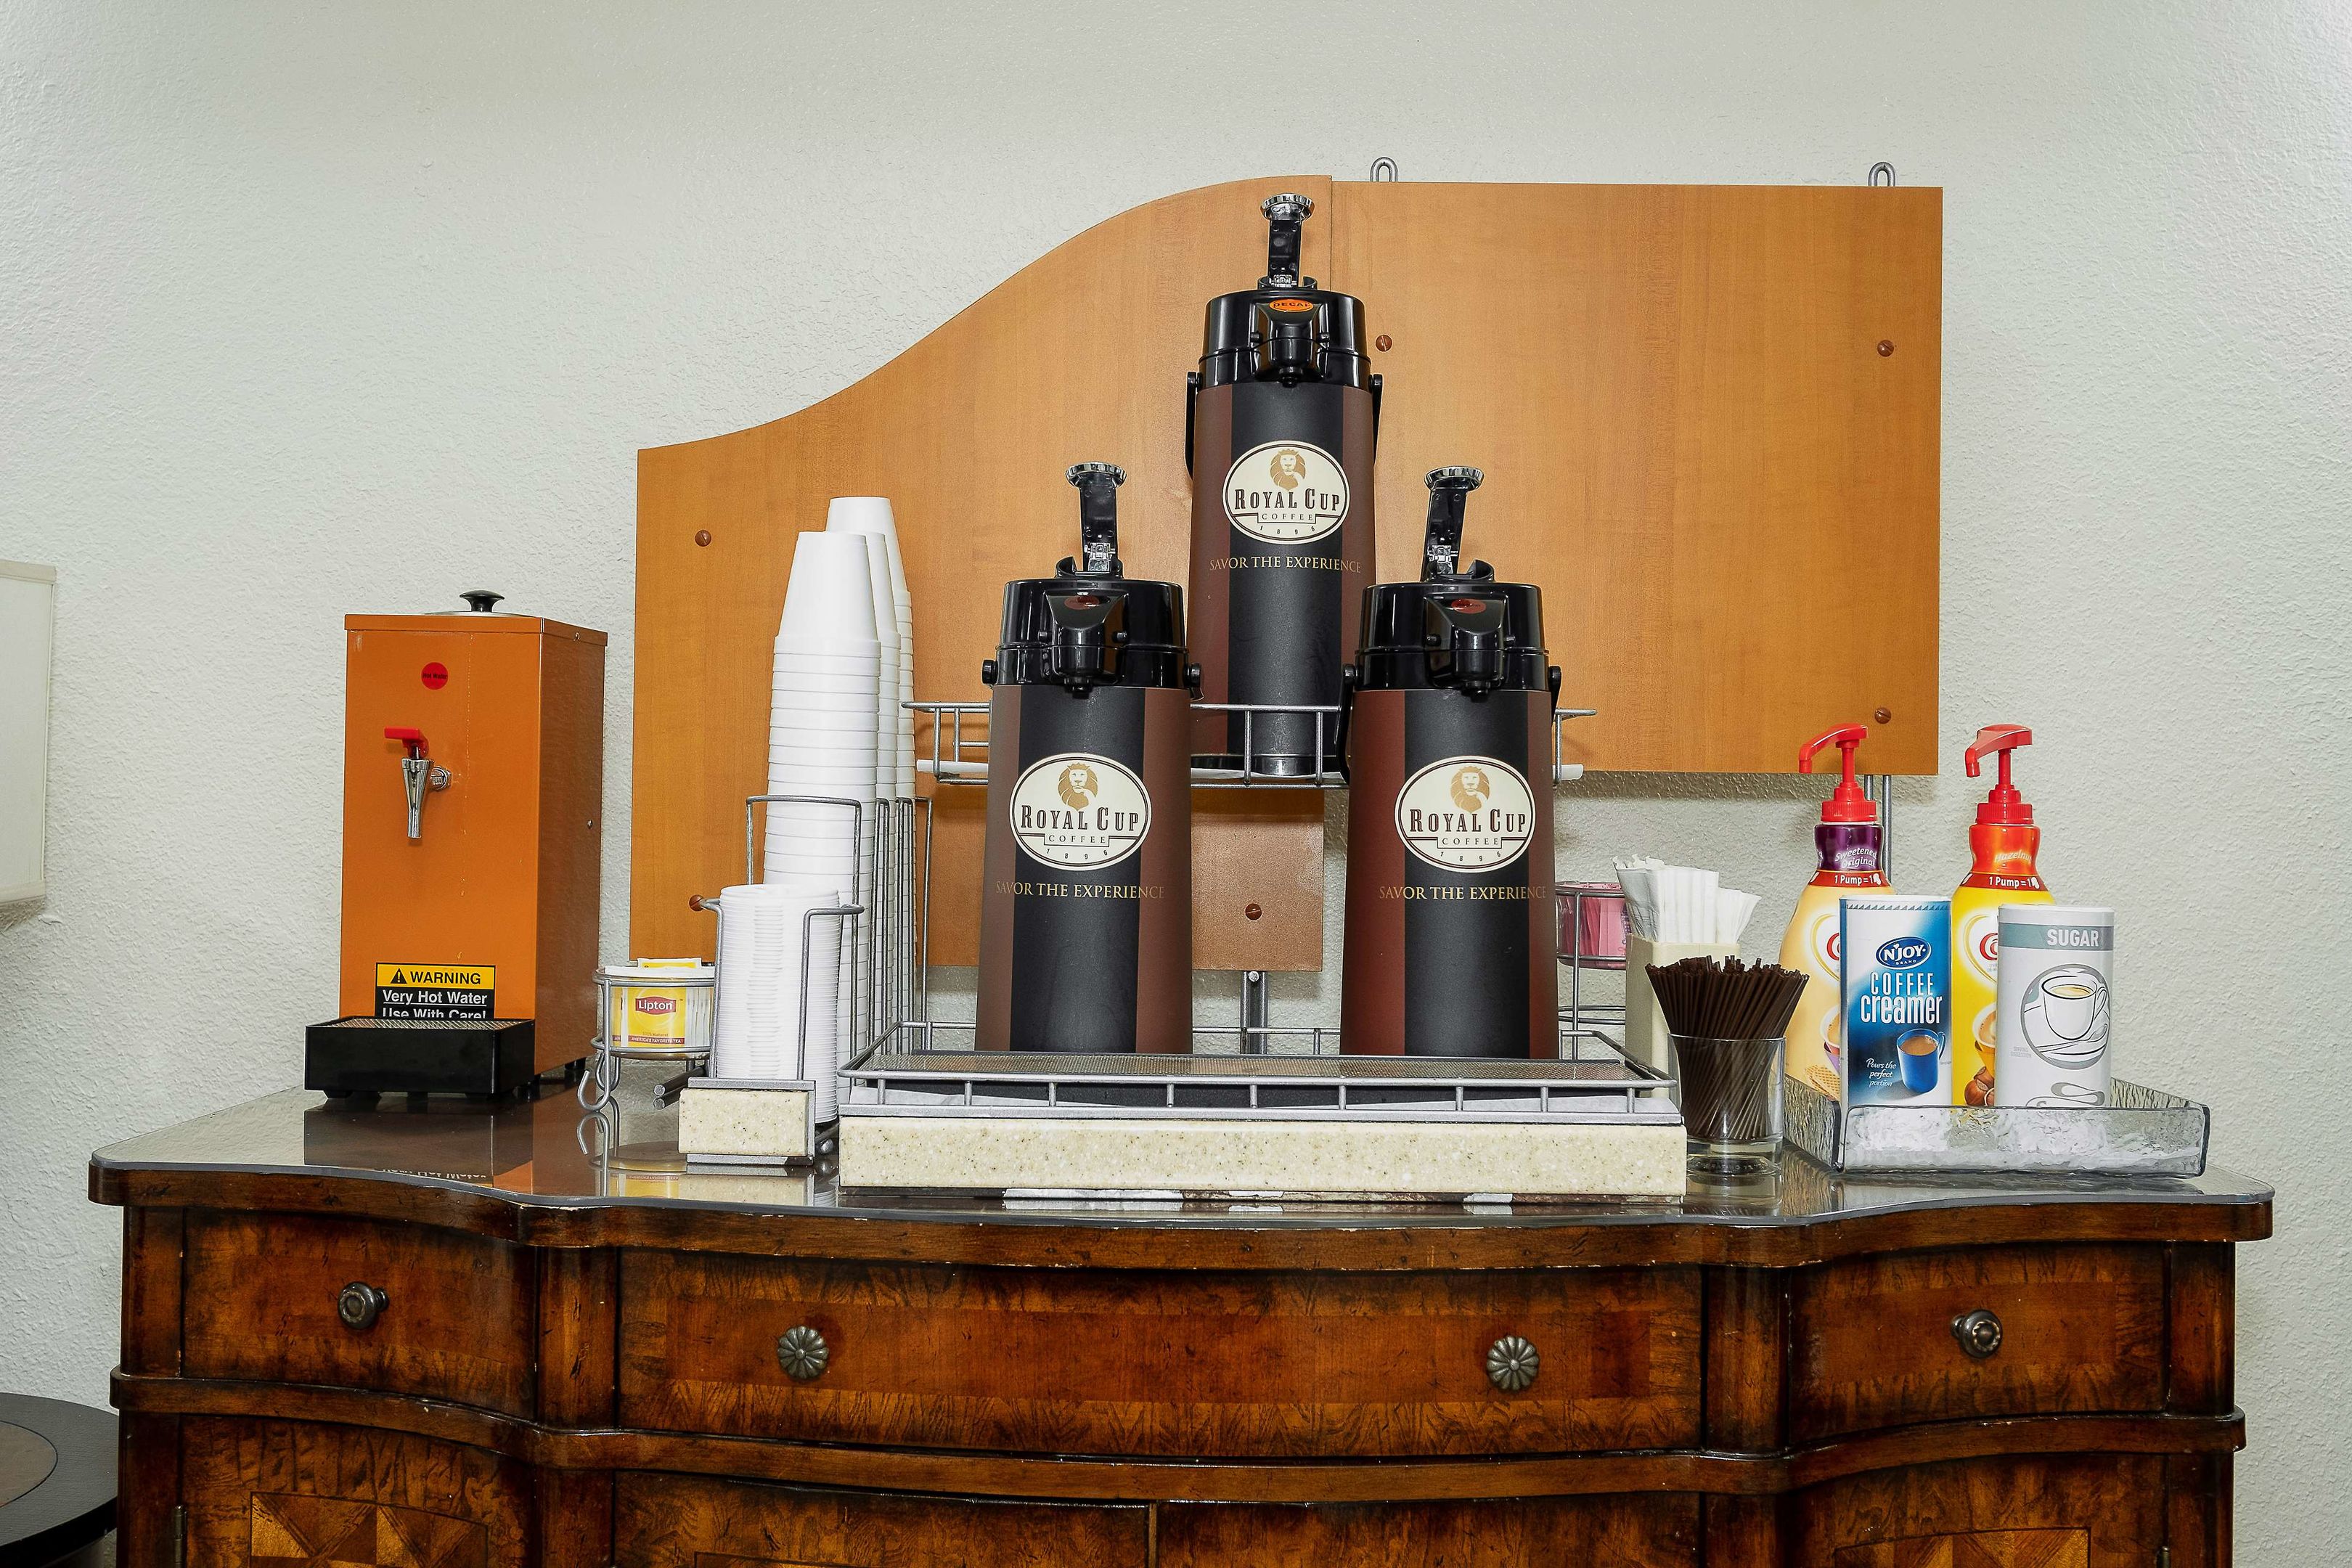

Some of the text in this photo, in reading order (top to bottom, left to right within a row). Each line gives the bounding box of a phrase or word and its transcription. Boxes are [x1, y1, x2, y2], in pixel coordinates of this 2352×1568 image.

[1234, 488, 1340, 511] ROYAL CUP
[1209, 556, 1361, 573] SAVOR THE EXPERIENCE
[1021, 804, 1139, 831] ROYAL CUP
[1410, 809, 1526, 833] ROYAL CUP
[1048, 835, 1106, 844] COFFEE
[1835, 847, 1878, 862] Sweetened
[1842, 857, 1876, 868] Original
[1834, 875, 1838, 883] 1
[1989, 876, 1993, 886] 1
[996, 881, 1164, 899] SAVOR THE EXPERIENCE
[1379, 886, 1547, 899] SAVOR THE EXPERIENCE
[2046, 928, 2099, 947] SUGAR
[410, 971, 481, 984] WARNING
[1871, 972, 1934, 995] COFFEE
[383, 989, 487, 1005] Very Hot Water
[638, 1000, 673, 1011] Lipton
[1861, 995, 1943, 1024] creamer
[383, 1008, 486, 1019] Use With Care!
[1866, 1058, 1885, 1069] Pours
[1869, 1069, 1893, 1079] perfect
